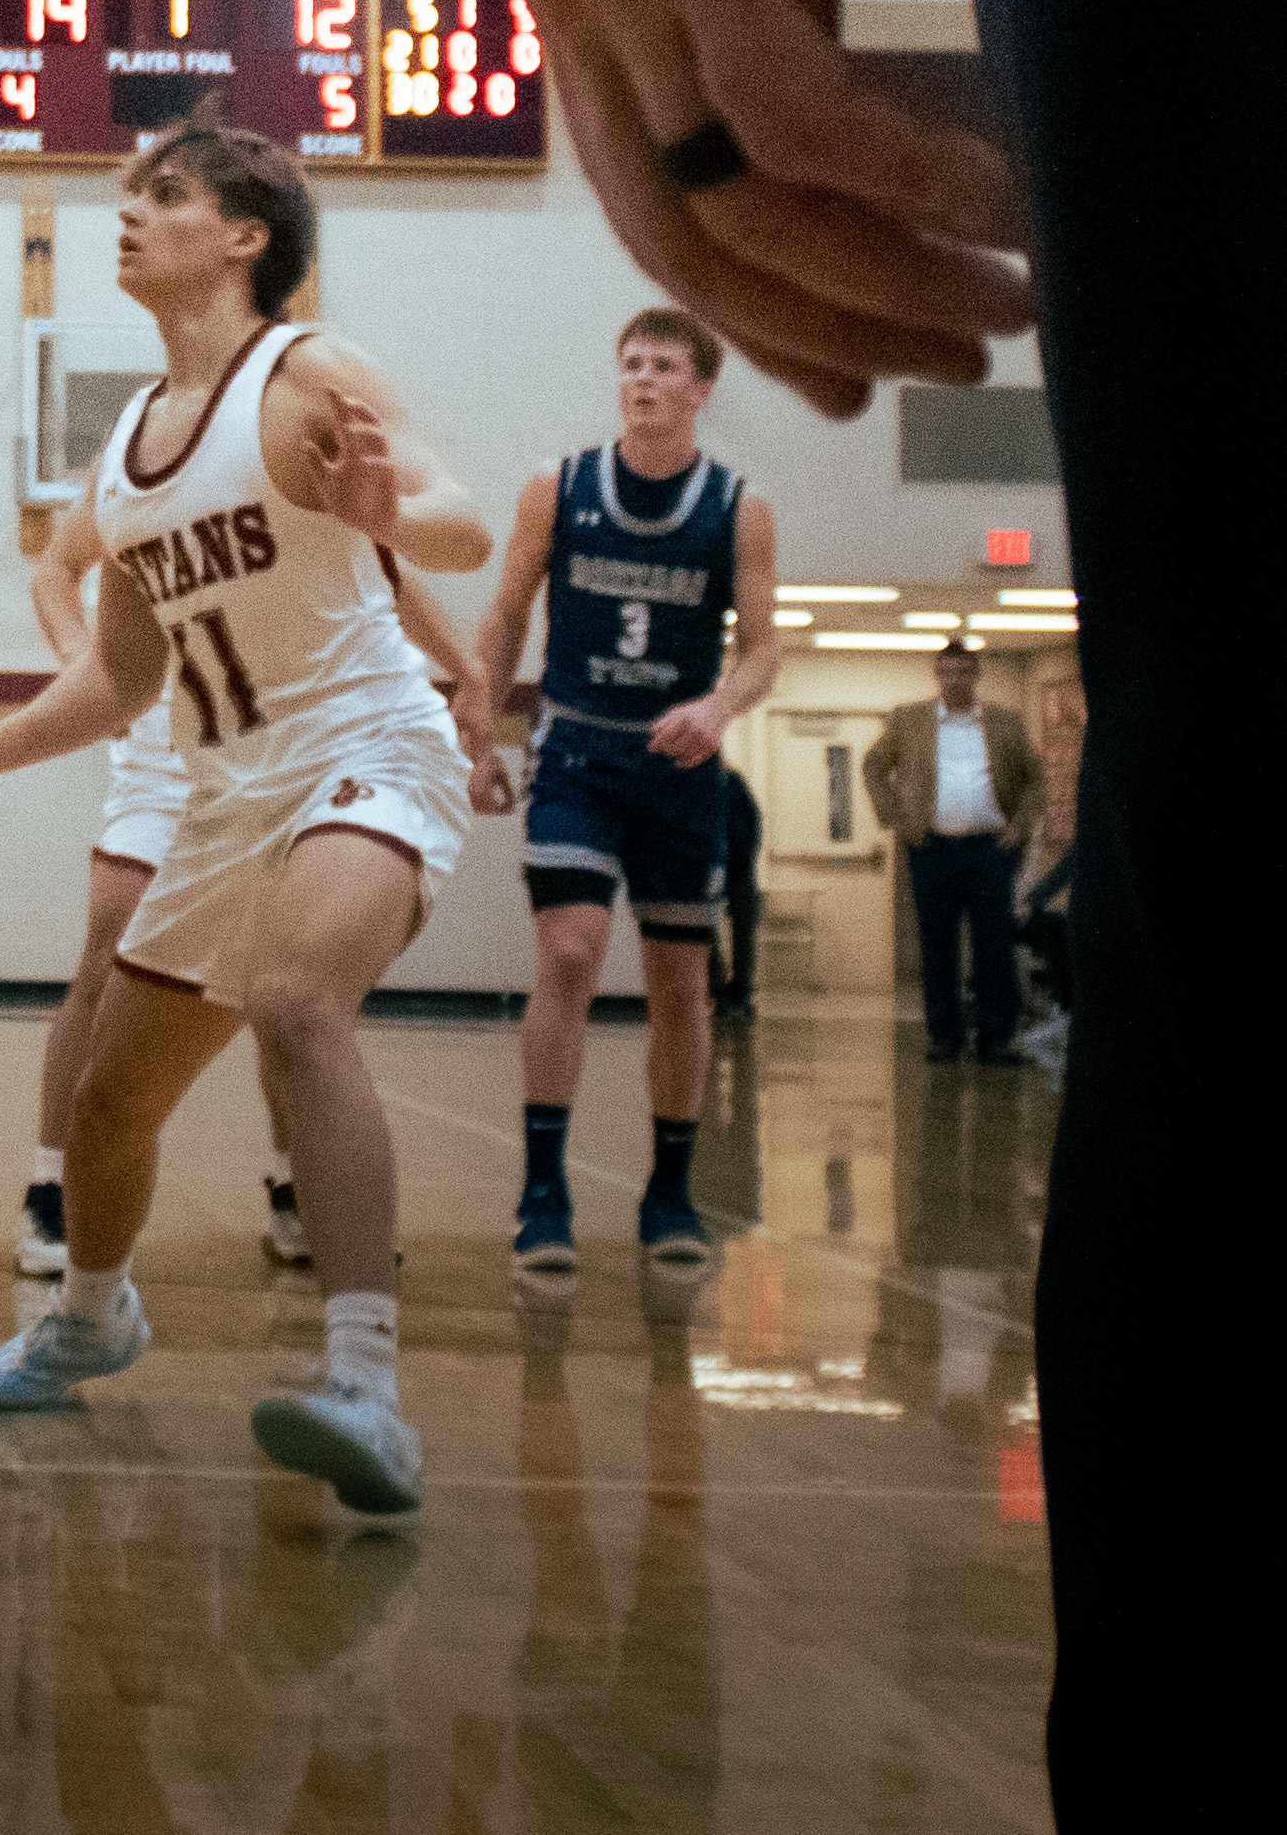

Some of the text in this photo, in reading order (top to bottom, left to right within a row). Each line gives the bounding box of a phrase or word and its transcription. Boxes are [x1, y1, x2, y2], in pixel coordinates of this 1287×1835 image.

[107, 51, 179, 72] PLAYER
[381, 28, 542, 76] 21 0 0
[318, 72, 358, 131] 5
[446, 71, 477, 117] 2
[482, 70, 516, 117] 0
[117, 501, 277, 604] ITANS
[617, 601, 651, 658] 3
[169, 607, 268, 748] 11
